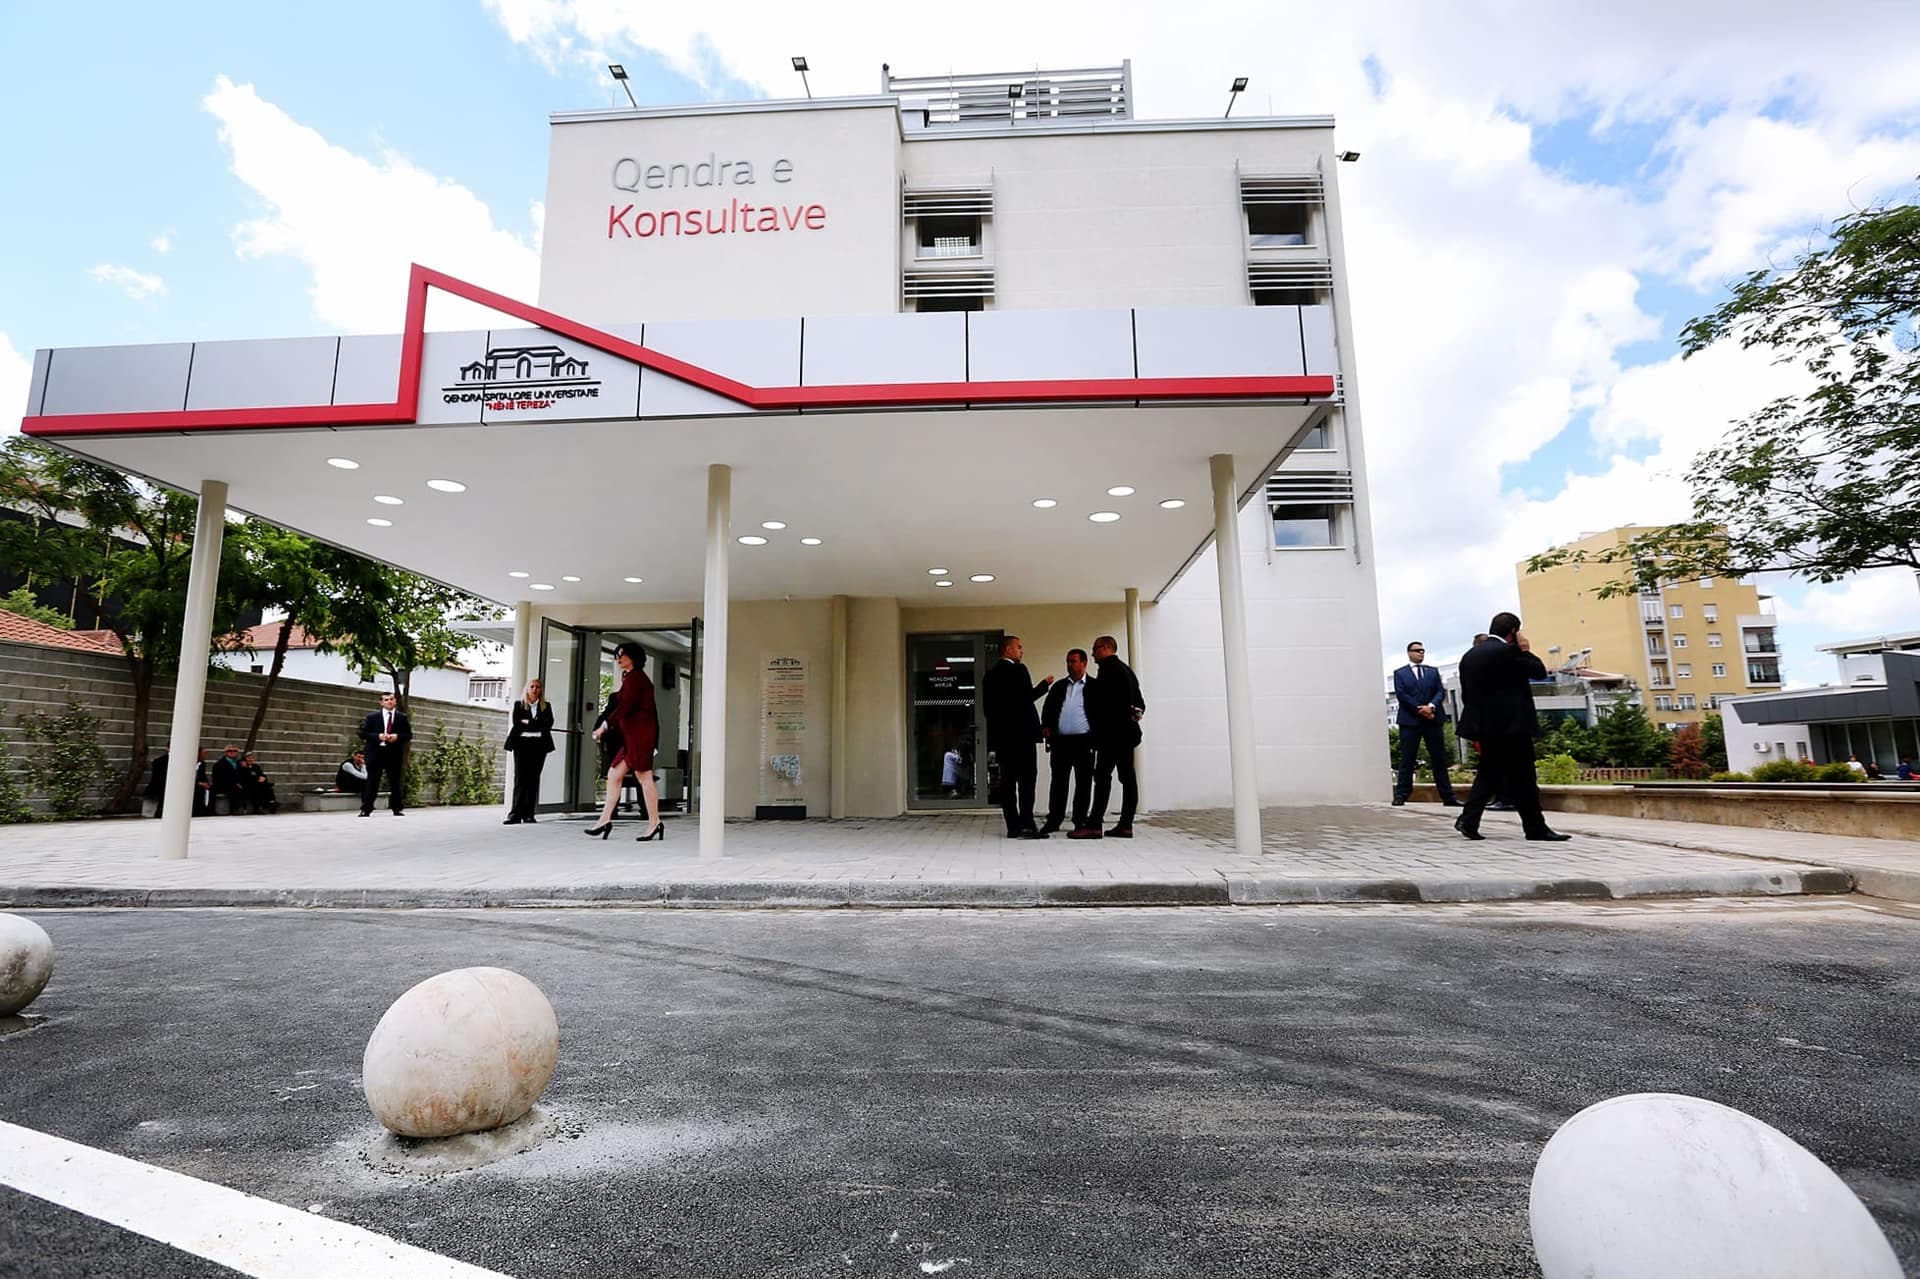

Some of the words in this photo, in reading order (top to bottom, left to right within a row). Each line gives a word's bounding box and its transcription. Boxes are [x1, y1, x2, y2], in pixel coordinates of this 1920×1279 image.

[612, 152, 755, 193] Qendra
[772, 158, 793, 184] e
[608, 198, 826, 239] Konsultave
[443, 393, 482, 404] QENDRA
[484, 391, 532, 401] SPITALORE
[533, 388, 599, 399] UNIVERSITARE
